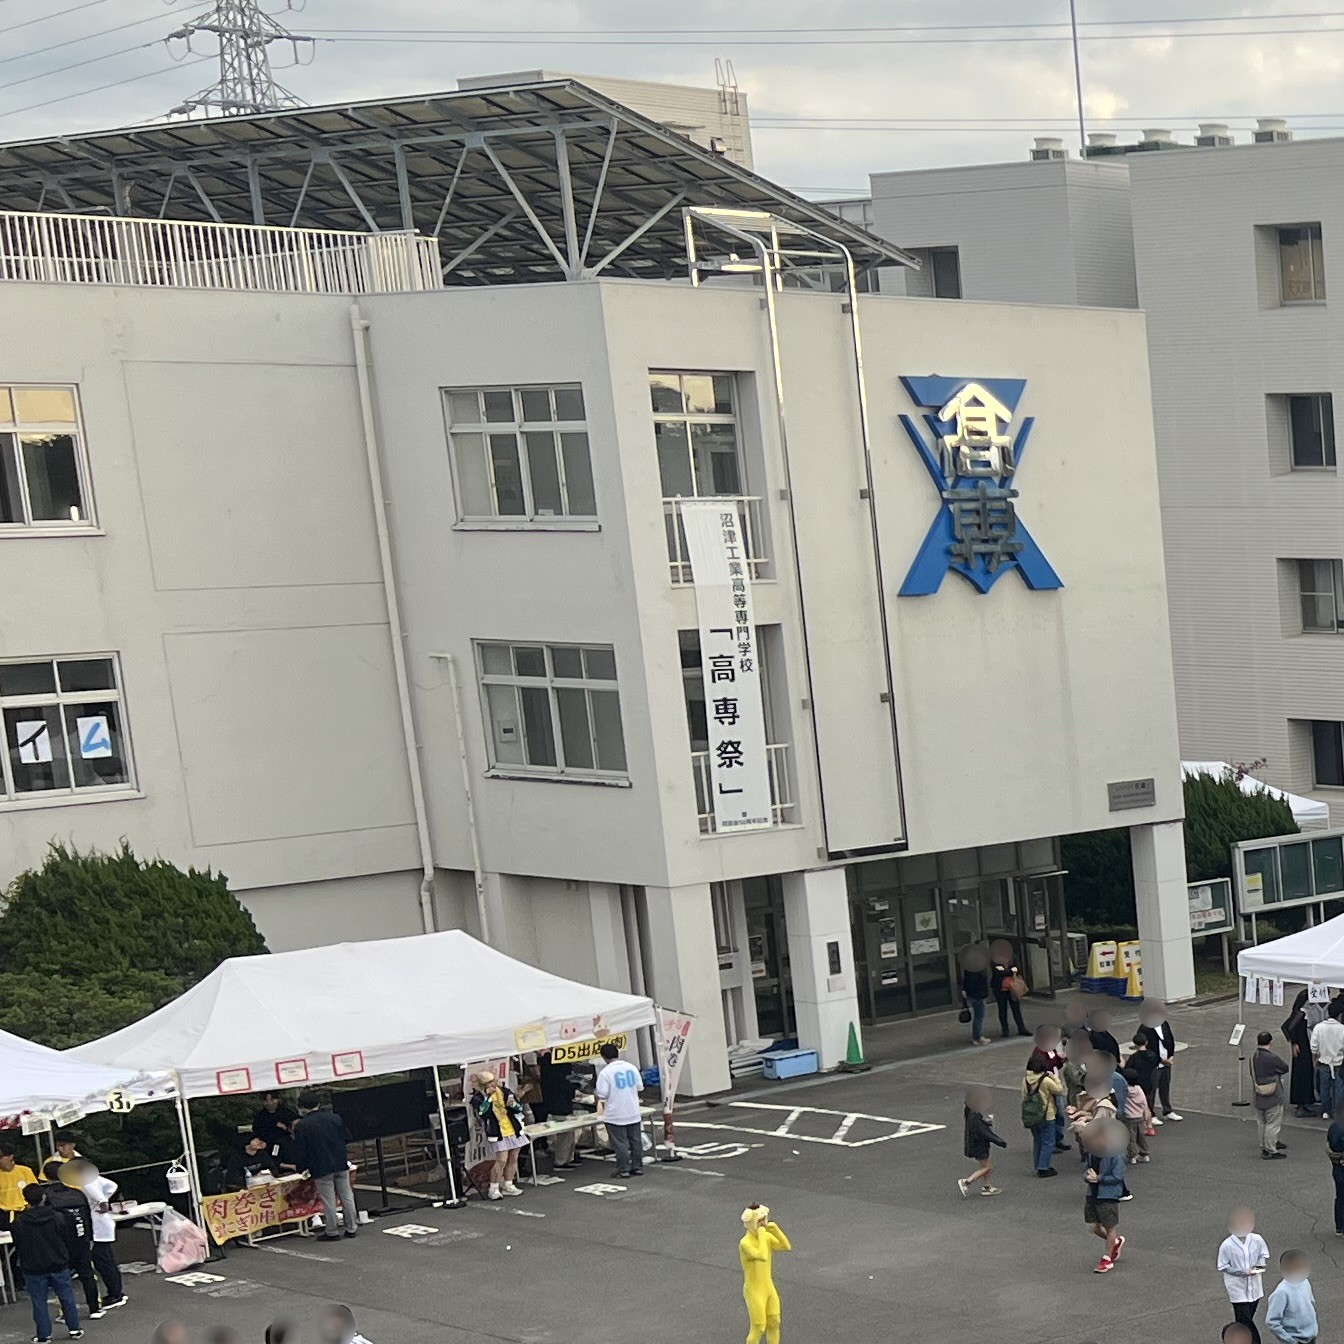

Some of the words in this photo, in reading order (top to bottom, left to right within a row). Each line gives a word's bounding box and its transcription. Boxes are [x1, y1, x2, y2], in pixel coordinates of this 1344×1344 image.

[720, 513, 754, 673] 沼津工業高等専門学校
[614, 1070, 636, 1090] 60
